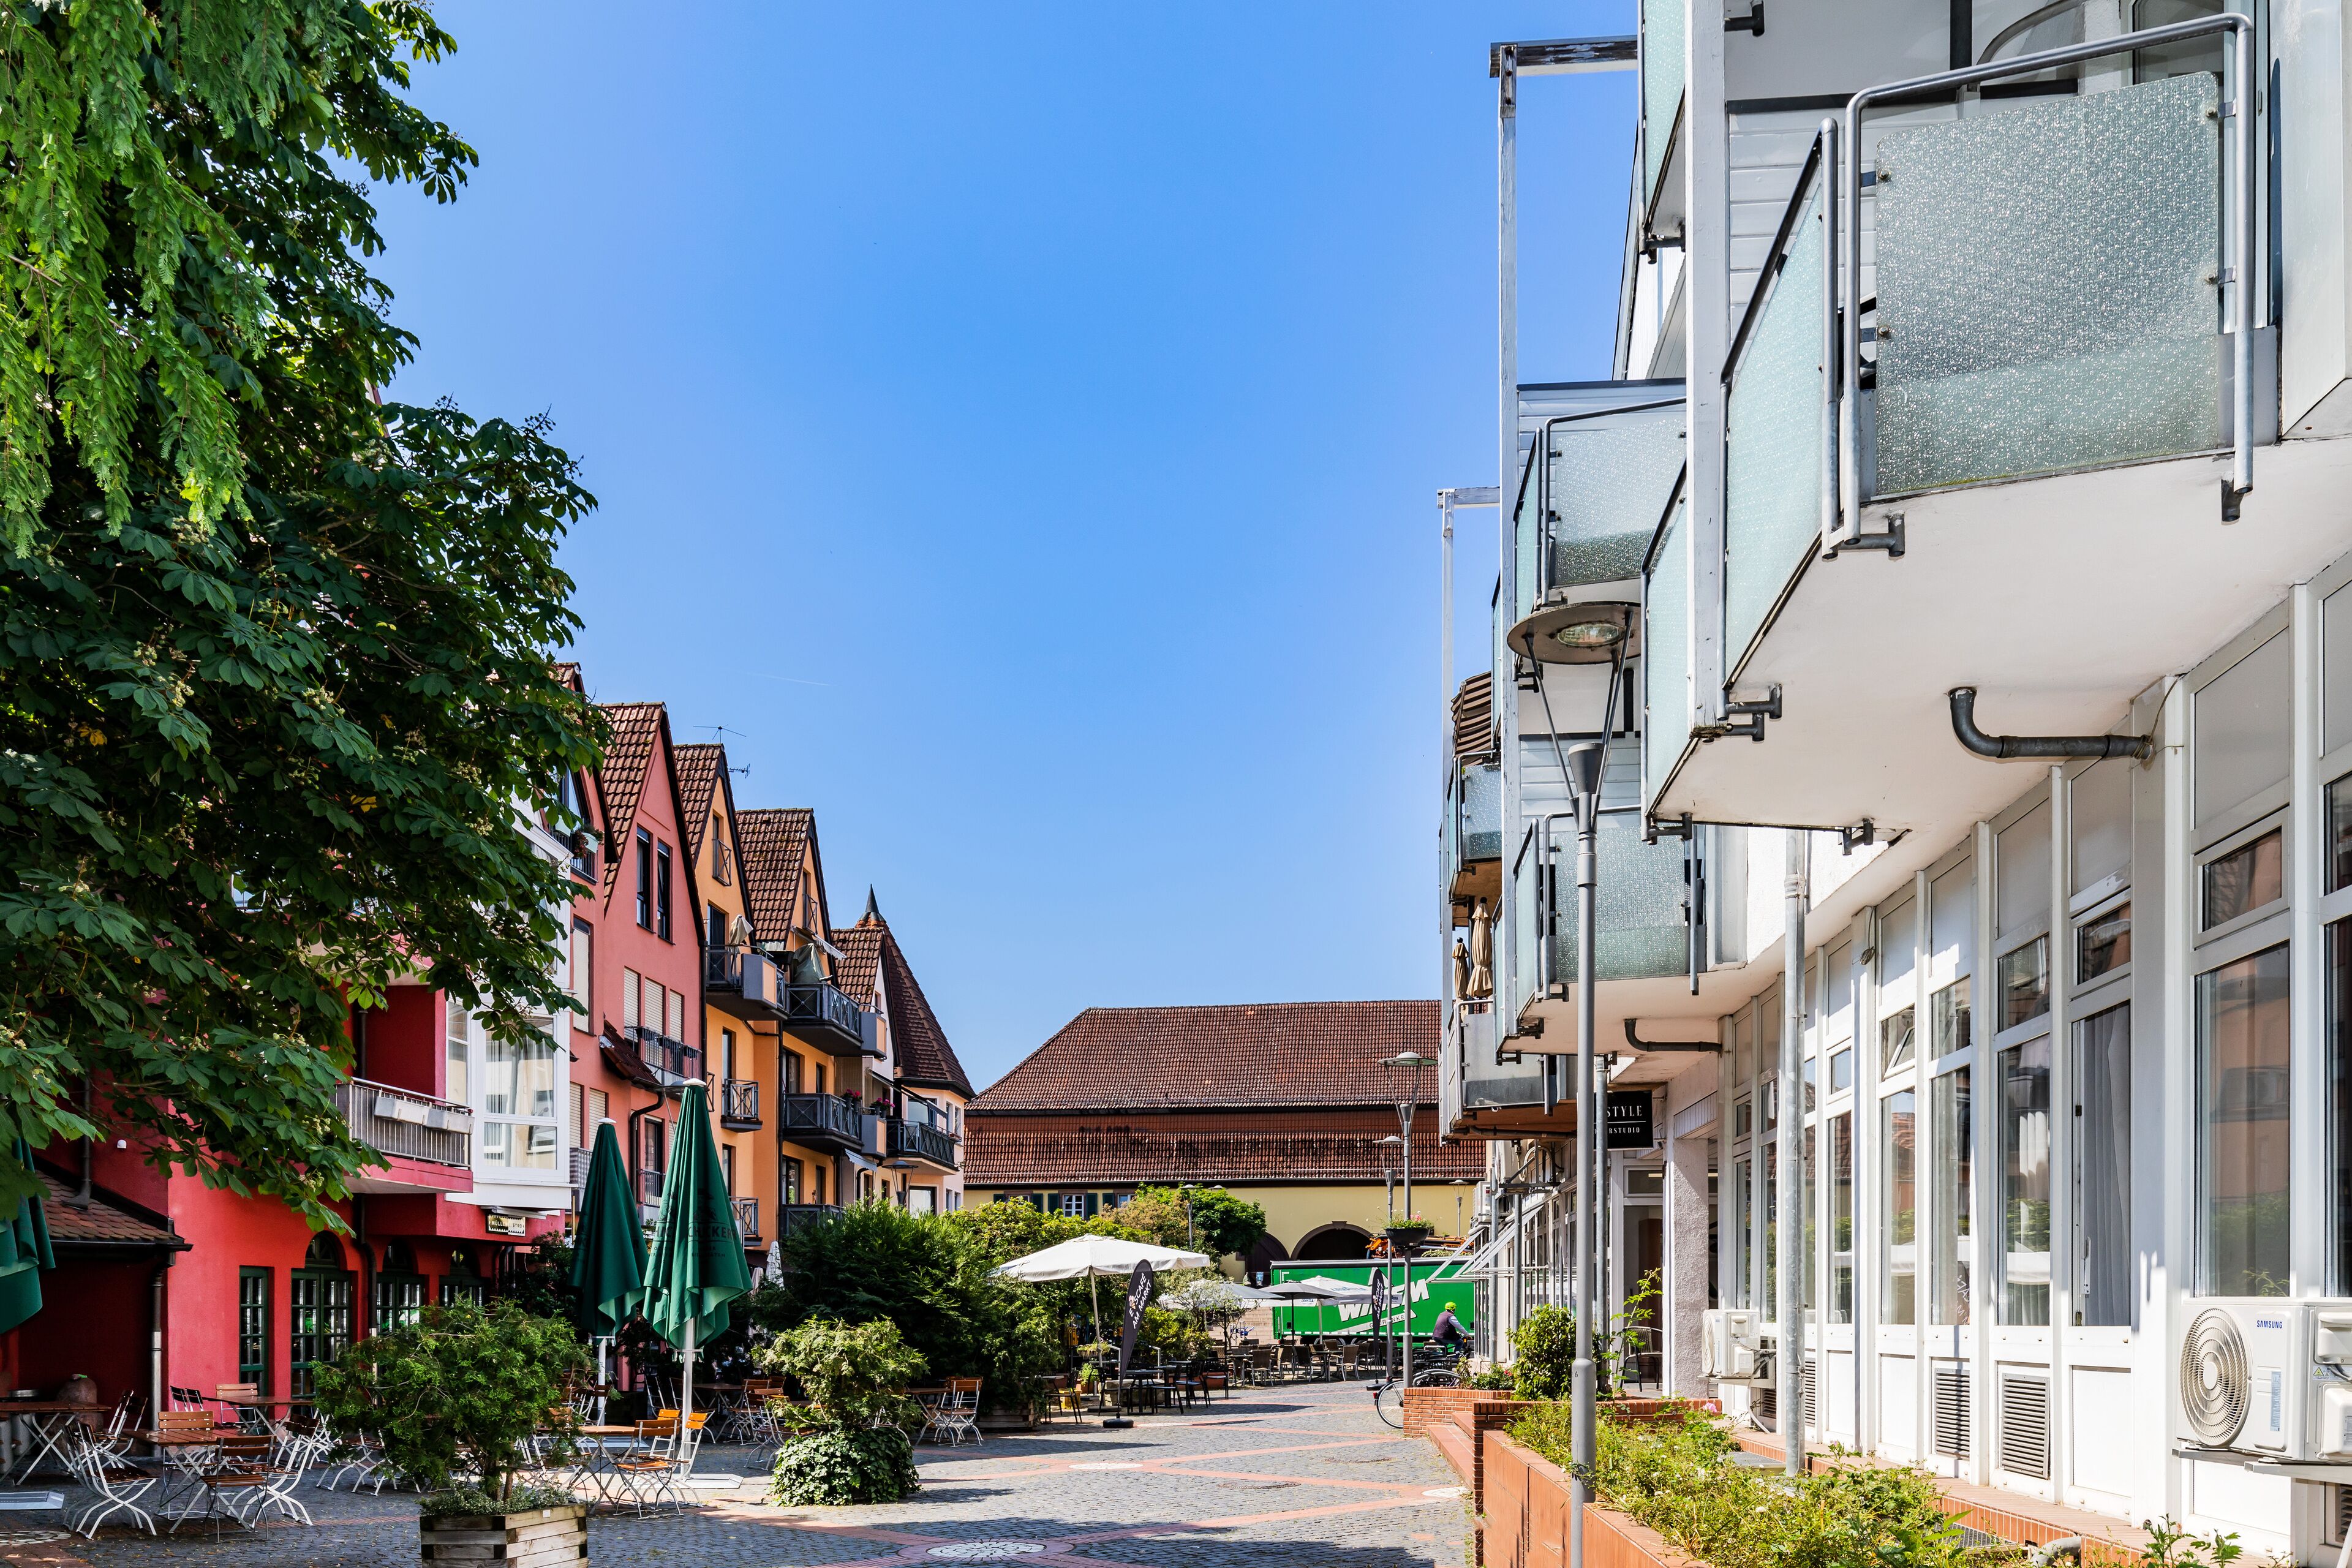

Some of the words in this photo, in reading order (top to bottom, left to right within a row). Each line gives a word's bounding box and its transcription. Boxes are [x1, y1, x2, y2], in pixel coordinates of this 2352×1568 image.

[1133, 1311, 1140, 1329] AM
[1138, 1279, 1152, 1311] MARKT
[2256, 1320, 2283, 1329] SAMSUNG
